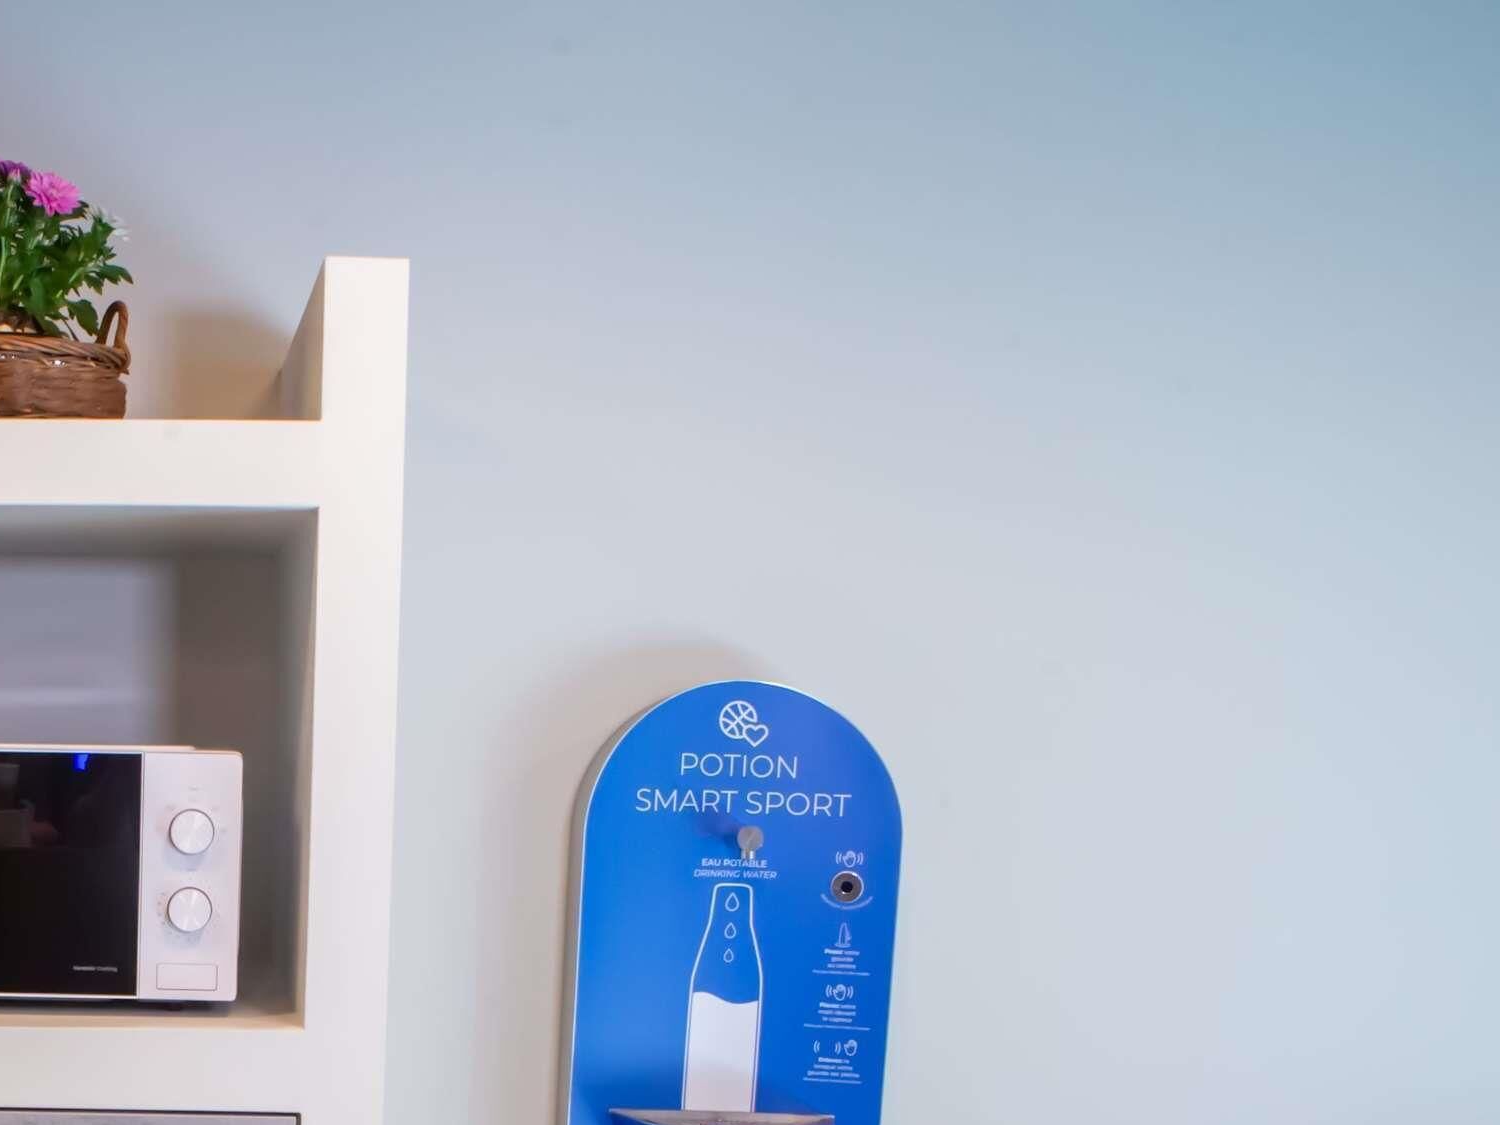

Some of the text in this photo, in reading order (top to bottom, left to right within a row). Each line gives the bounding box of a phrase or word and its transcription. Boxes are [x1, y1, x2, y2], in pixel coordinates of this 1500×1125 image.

[679, 752, 798, 779] POTION
[635, 787, 853, 818] SMART SPORT
[701, 857, 768, 869] EAU POTABLE
[693, 868, 778, 880] DRINKING WATER
